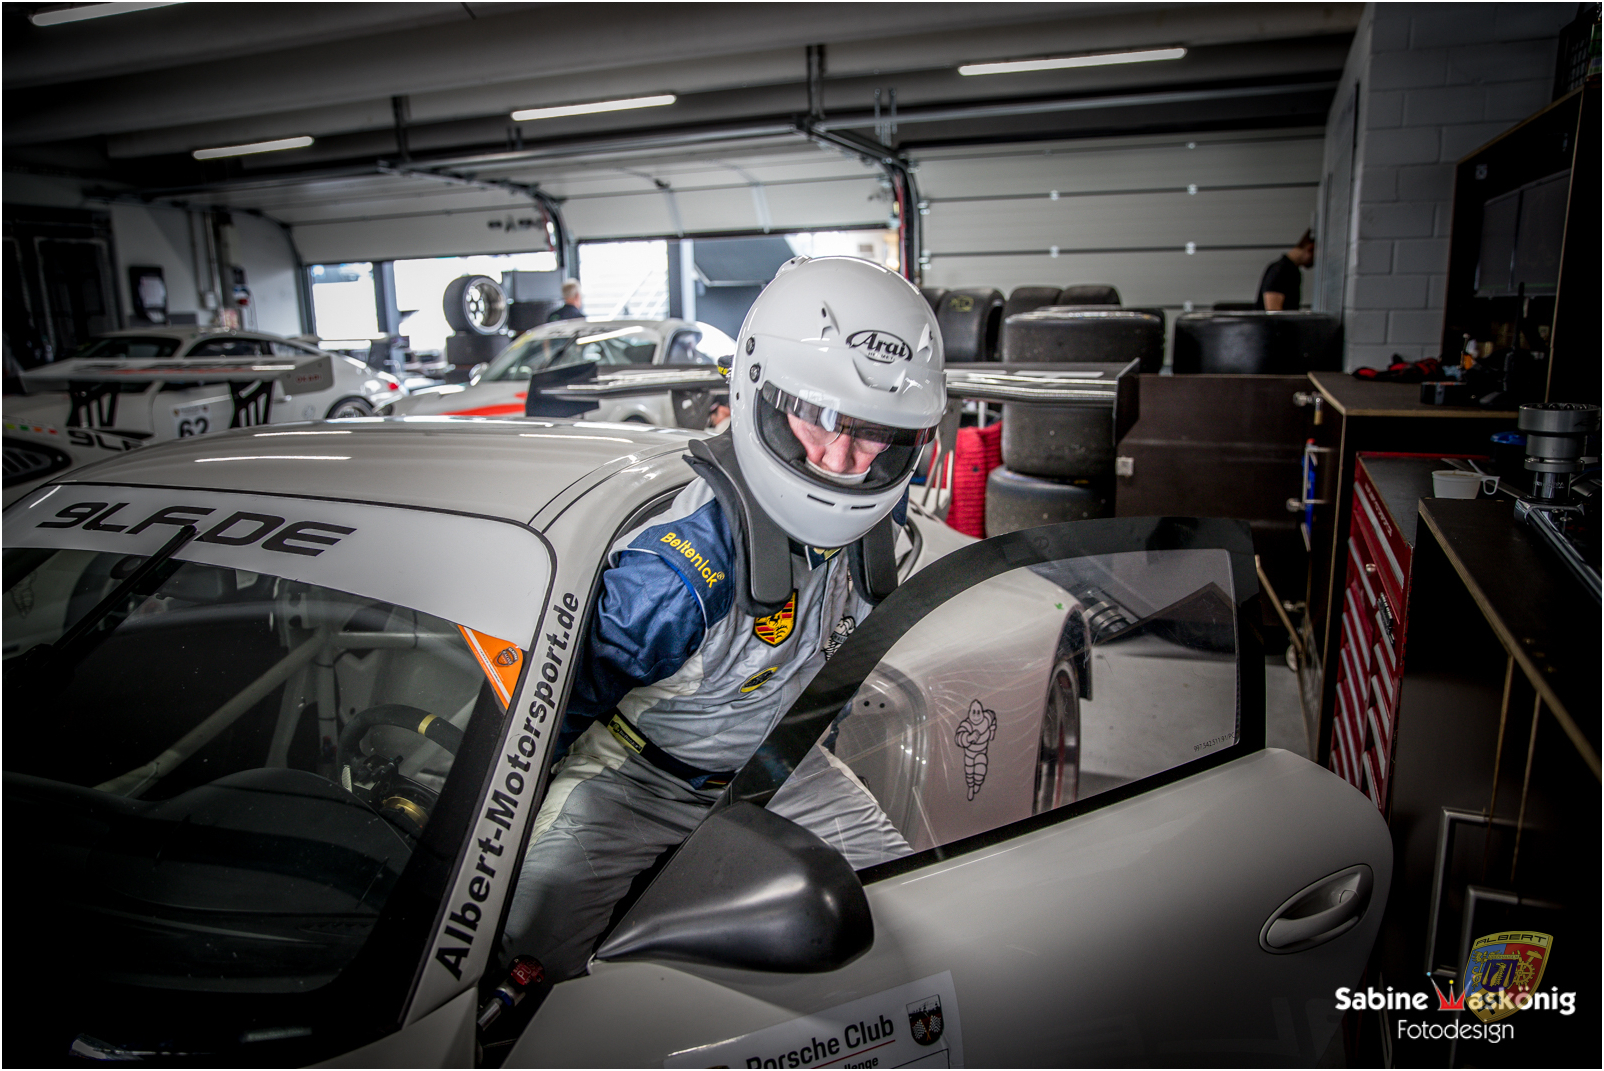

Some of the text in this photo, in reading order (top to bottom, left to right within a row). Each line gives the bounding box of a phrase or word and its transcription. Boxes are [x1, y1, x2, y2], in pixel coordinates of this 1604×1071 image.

[850, 332, 907, 358] Arai
[178, 417, 208, 437] 62
[435, 592, 579, 981] Albert-Motorsport.de
[844, 1014, 895, 1049] Club
